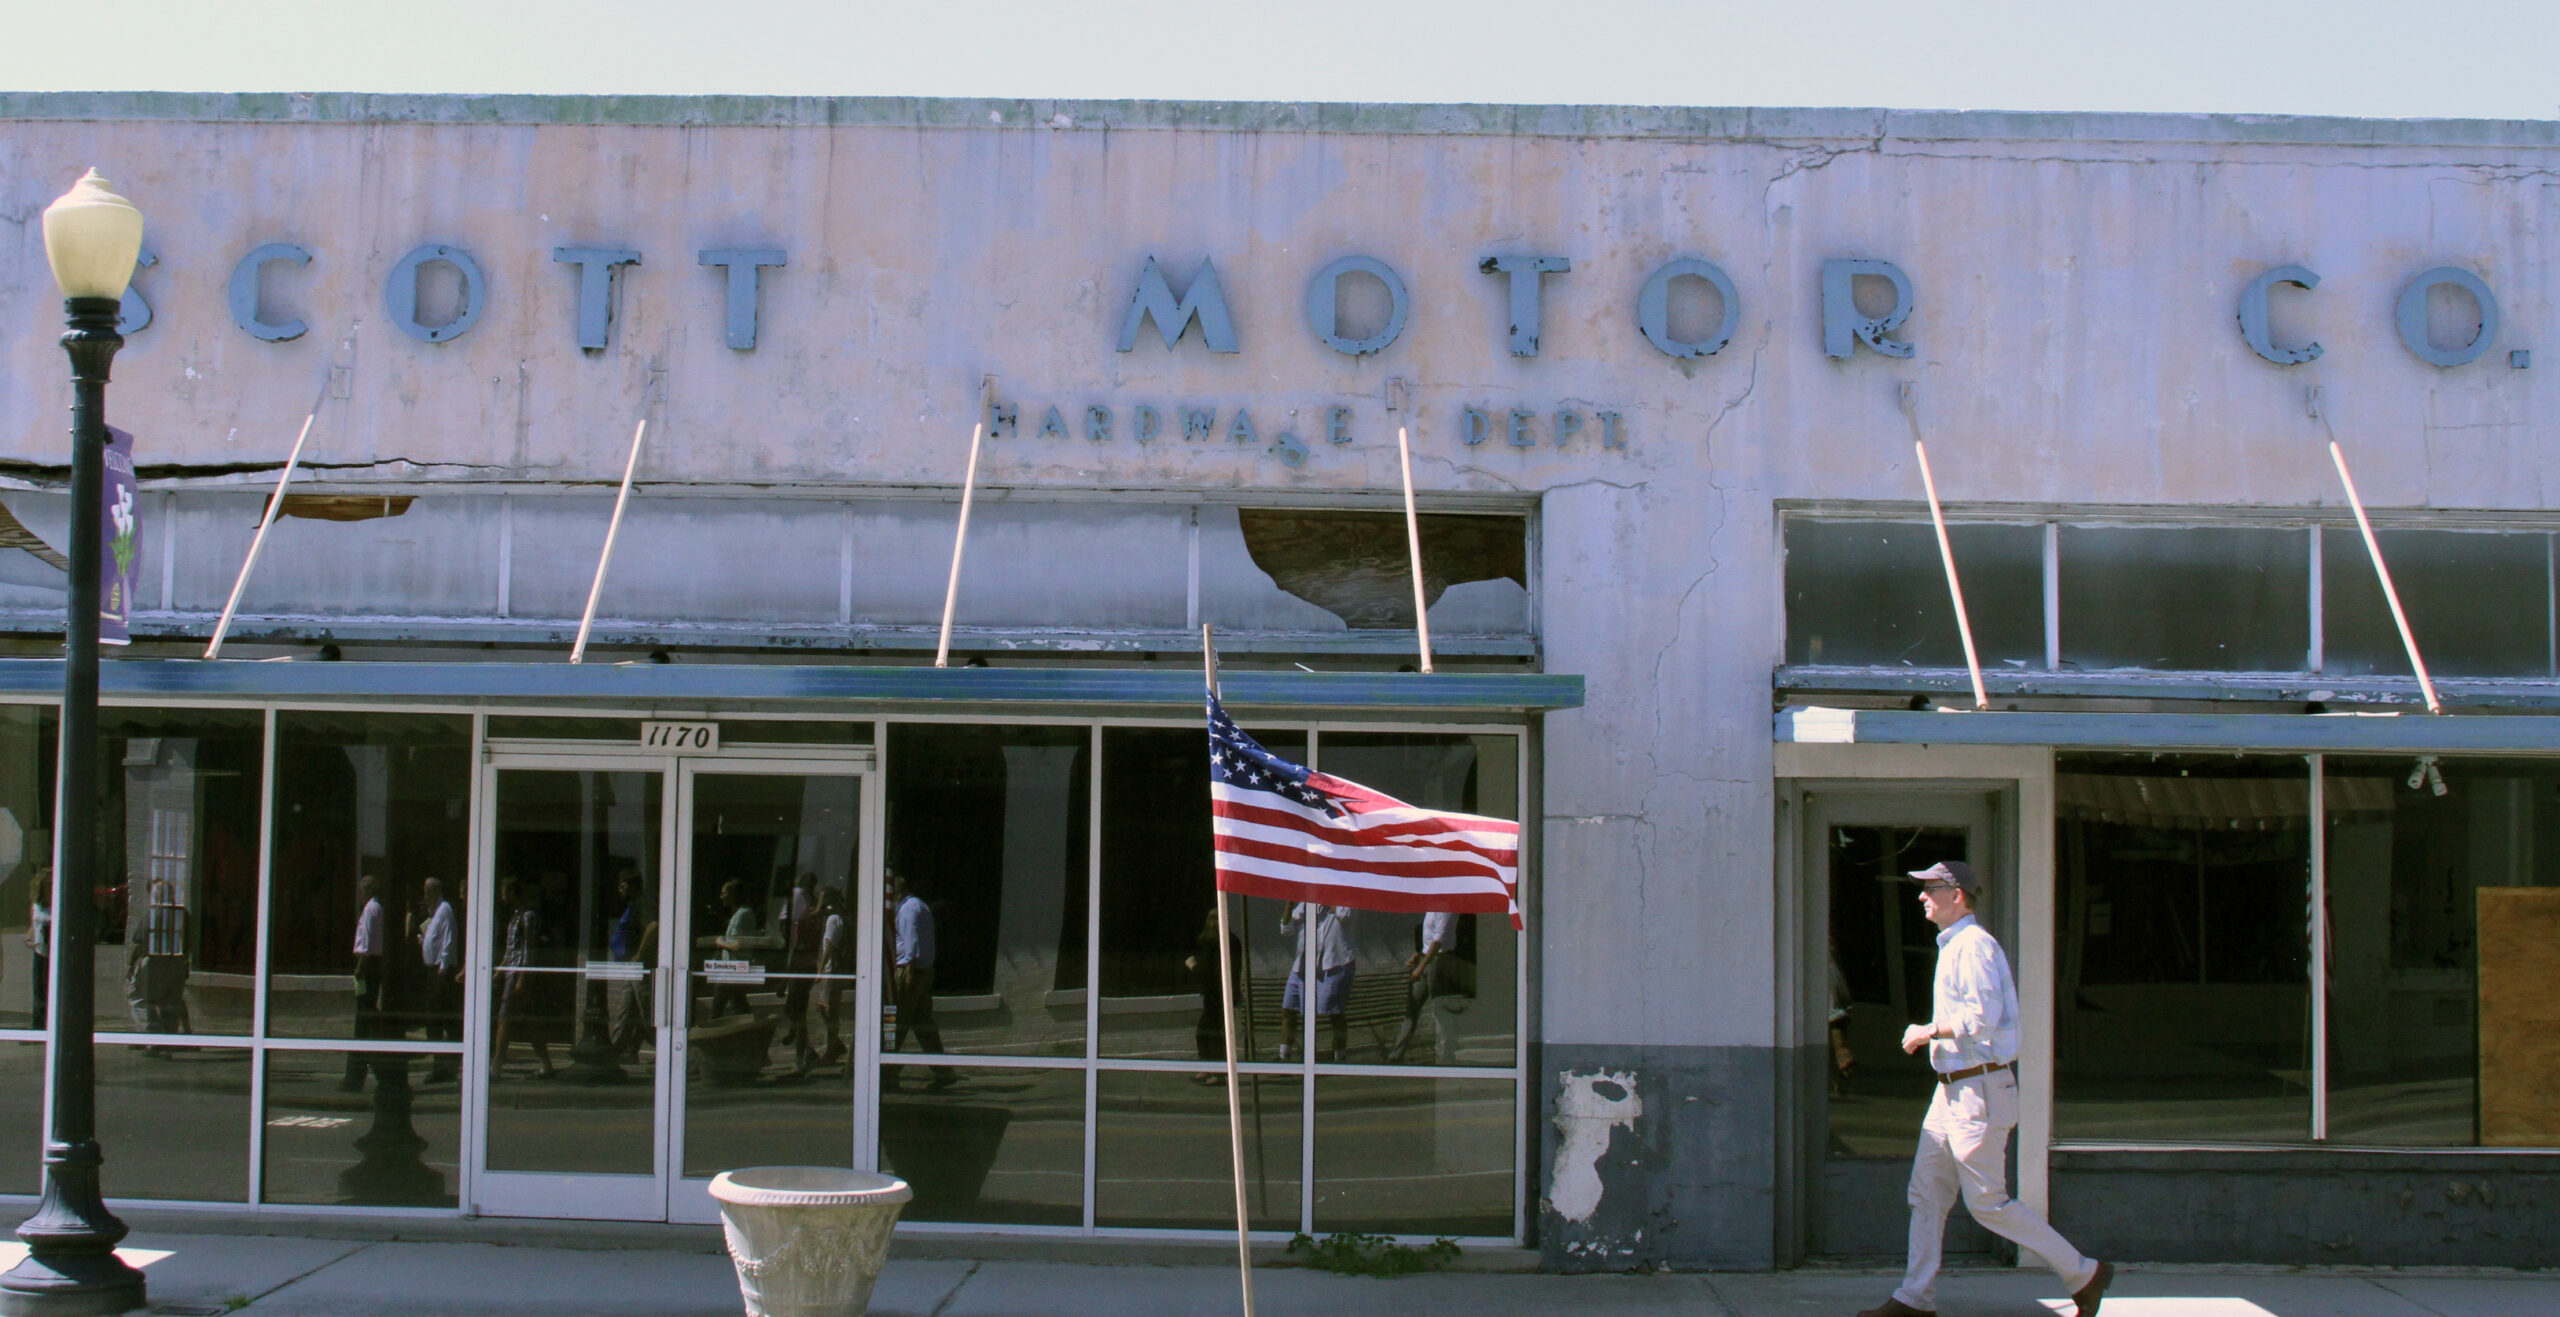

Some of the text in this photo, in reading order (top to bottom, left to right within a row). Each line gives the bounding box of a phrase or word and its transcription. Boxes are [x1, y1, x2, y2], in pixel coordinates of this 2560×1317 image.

[1115, 254, 1916, 360] MOTOR
[2238, 265, 2531, 368] CO.
[648, 726, 710, 748] 1170
